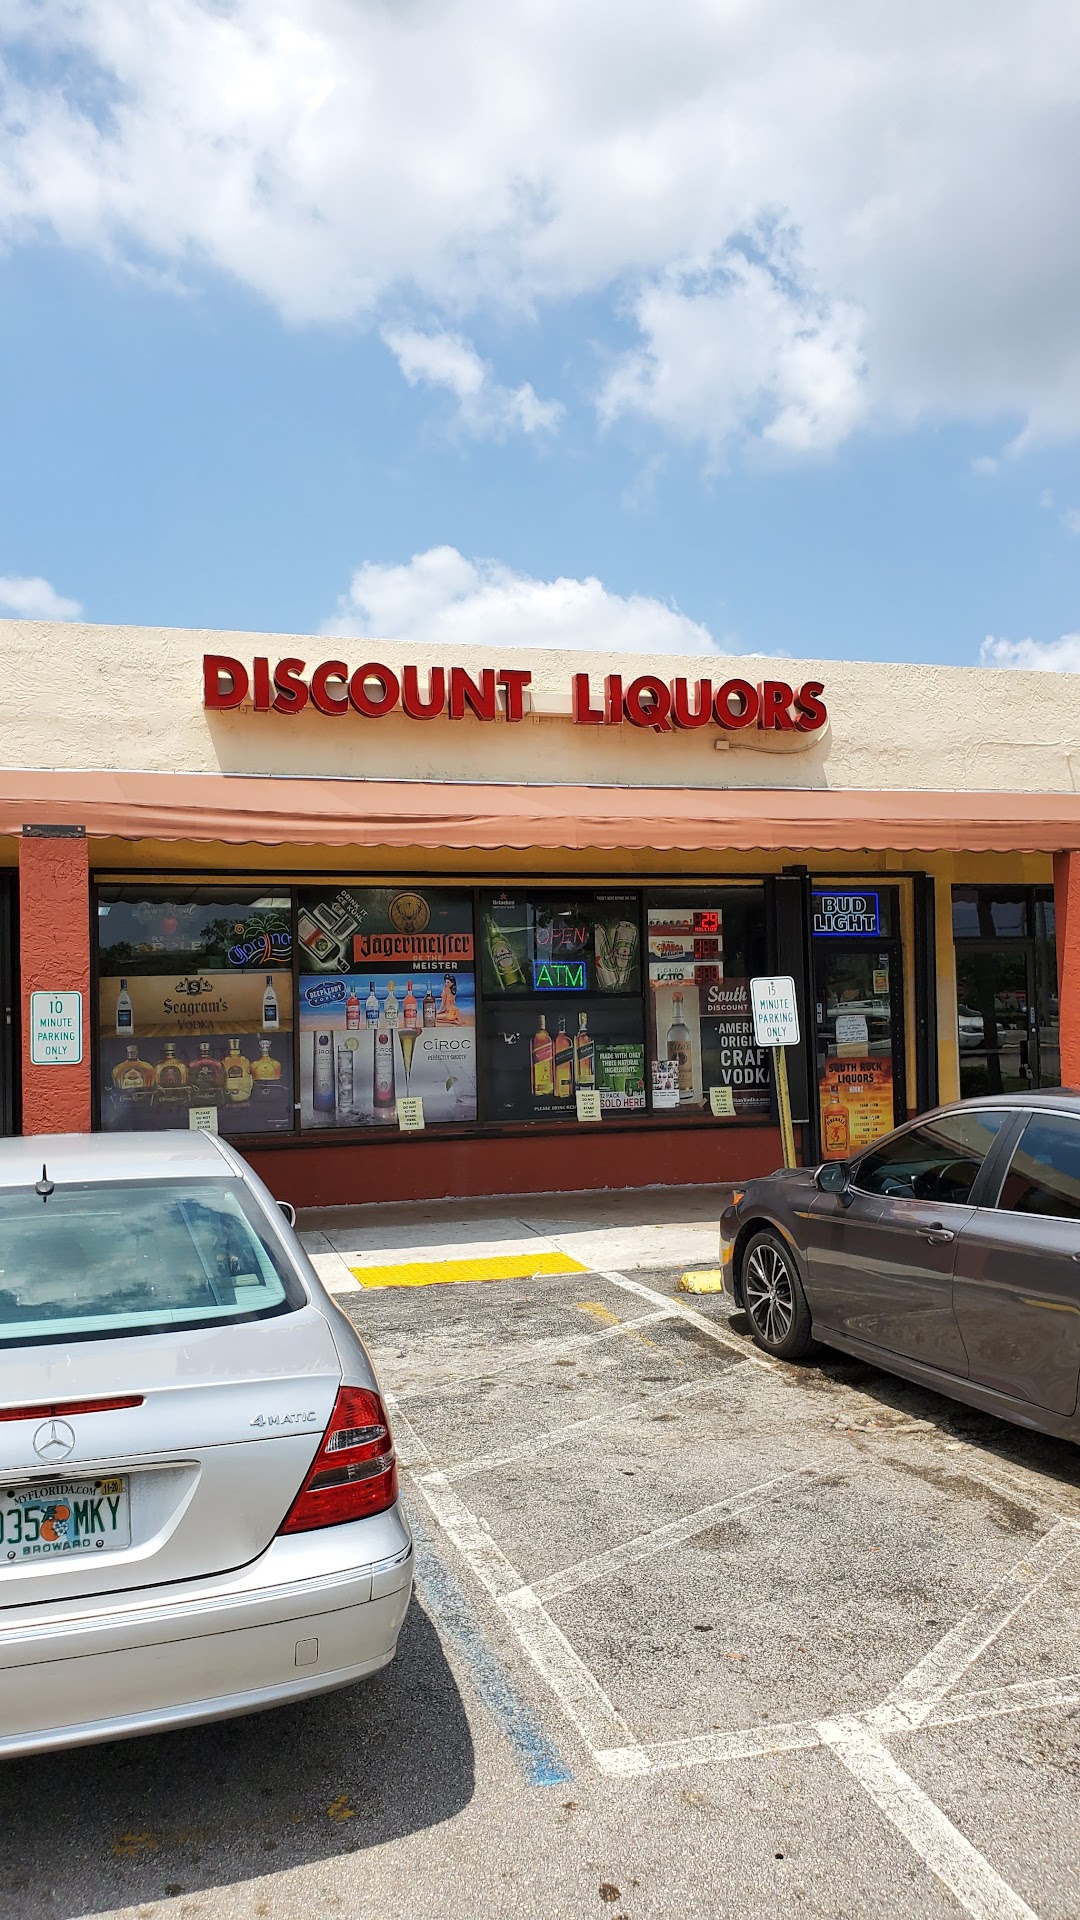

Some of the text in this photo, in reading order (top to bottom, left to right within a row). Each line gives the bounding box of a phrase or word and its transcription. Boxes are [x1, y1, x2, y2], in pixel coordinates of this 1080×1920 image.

[203, 654, 829, 733] DISCOUNT LIQUORS
[336, 895, 348, 906] ICE
[340, 889, 369, 917] DRINK IT
[821, 896, 867, 914] BUD
[701, 912, 718, 928] 29
[813, 914, 876, 932] LIGHT
[537, 928, 586, 945] OPEN
[227, 933, 292, 965] Corona
[412, 962, 458, 970] MEISTER
[536, 965, 583, 987] ATM
[657, 972, 684, 980] LOTTO
[707, 985, 748, 1003] South
[767, 986, 777, 996] 15
[49, 1001, 63, 1014] 10
[163, 998, 229, 1017] Seagram's
[760, 999, 789, 1010] MINUTE
[40, 1018, 72, 1027] MINUTE
[759, 1012, 793, 1024] PARKING
[176, 1019, 215, 1031] VODKA
[718, 1023, 754, 1034] AMERI
[37, 1032, 76, 1041] PARKING
[766, 1026, 787, 1038] ONLY
[45, 1046, 68, 1055] ONLY
[828, 1061, 882, 1073] SOUTH ROCK
[837, 1073, 875, 1085] LIQUORS
[600, 1098, 645, 1108] SOLD HERE
[249, 1411, 317, 1427] 4MATIC
[103, 1484, 119, 1493] 11-20
[14, 1485, 97, 1505] MYFLORIDA.COM
[73, 1496, 120, 1536] MKY
[23, 1539, 91, 1555] BROWARD
